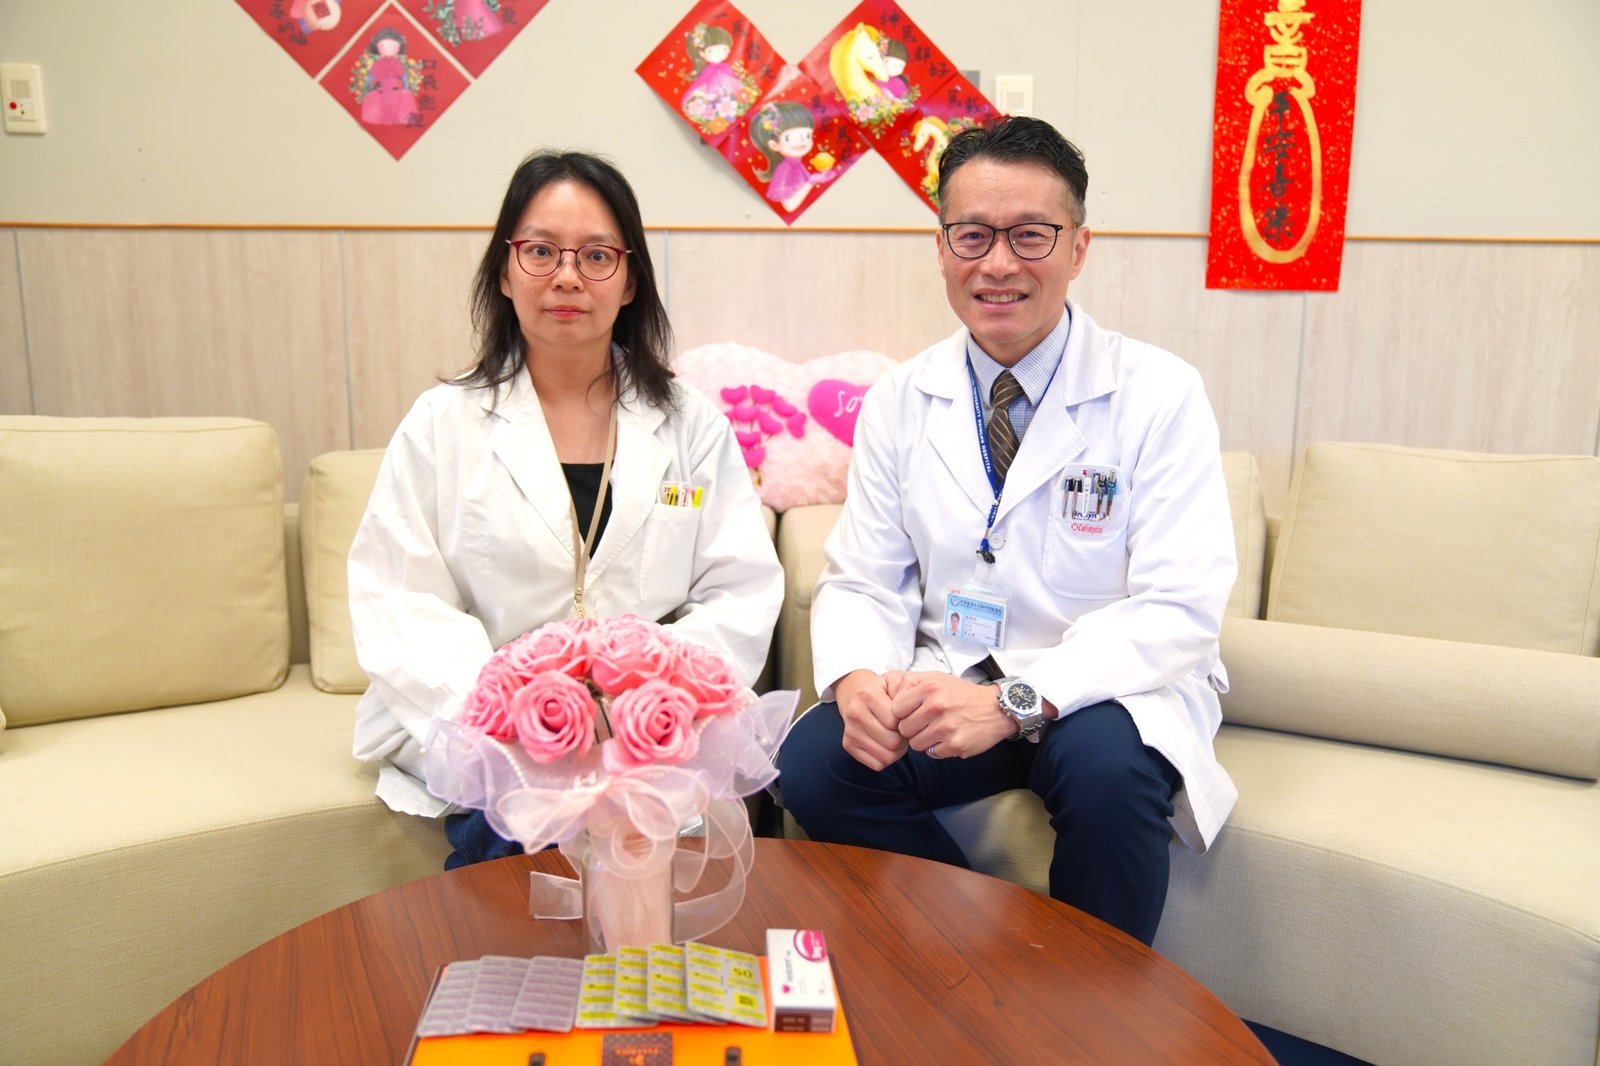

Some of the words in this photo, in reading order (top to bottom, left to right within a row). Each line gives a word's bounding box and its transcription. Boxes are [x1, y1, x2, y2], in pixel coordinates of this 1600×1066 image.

[880, 8, 950, 78] 神馬都好
[1261, 91, 1296, 243] 平安喜樂
[981, 443, 992, 473] HOSPITAL
